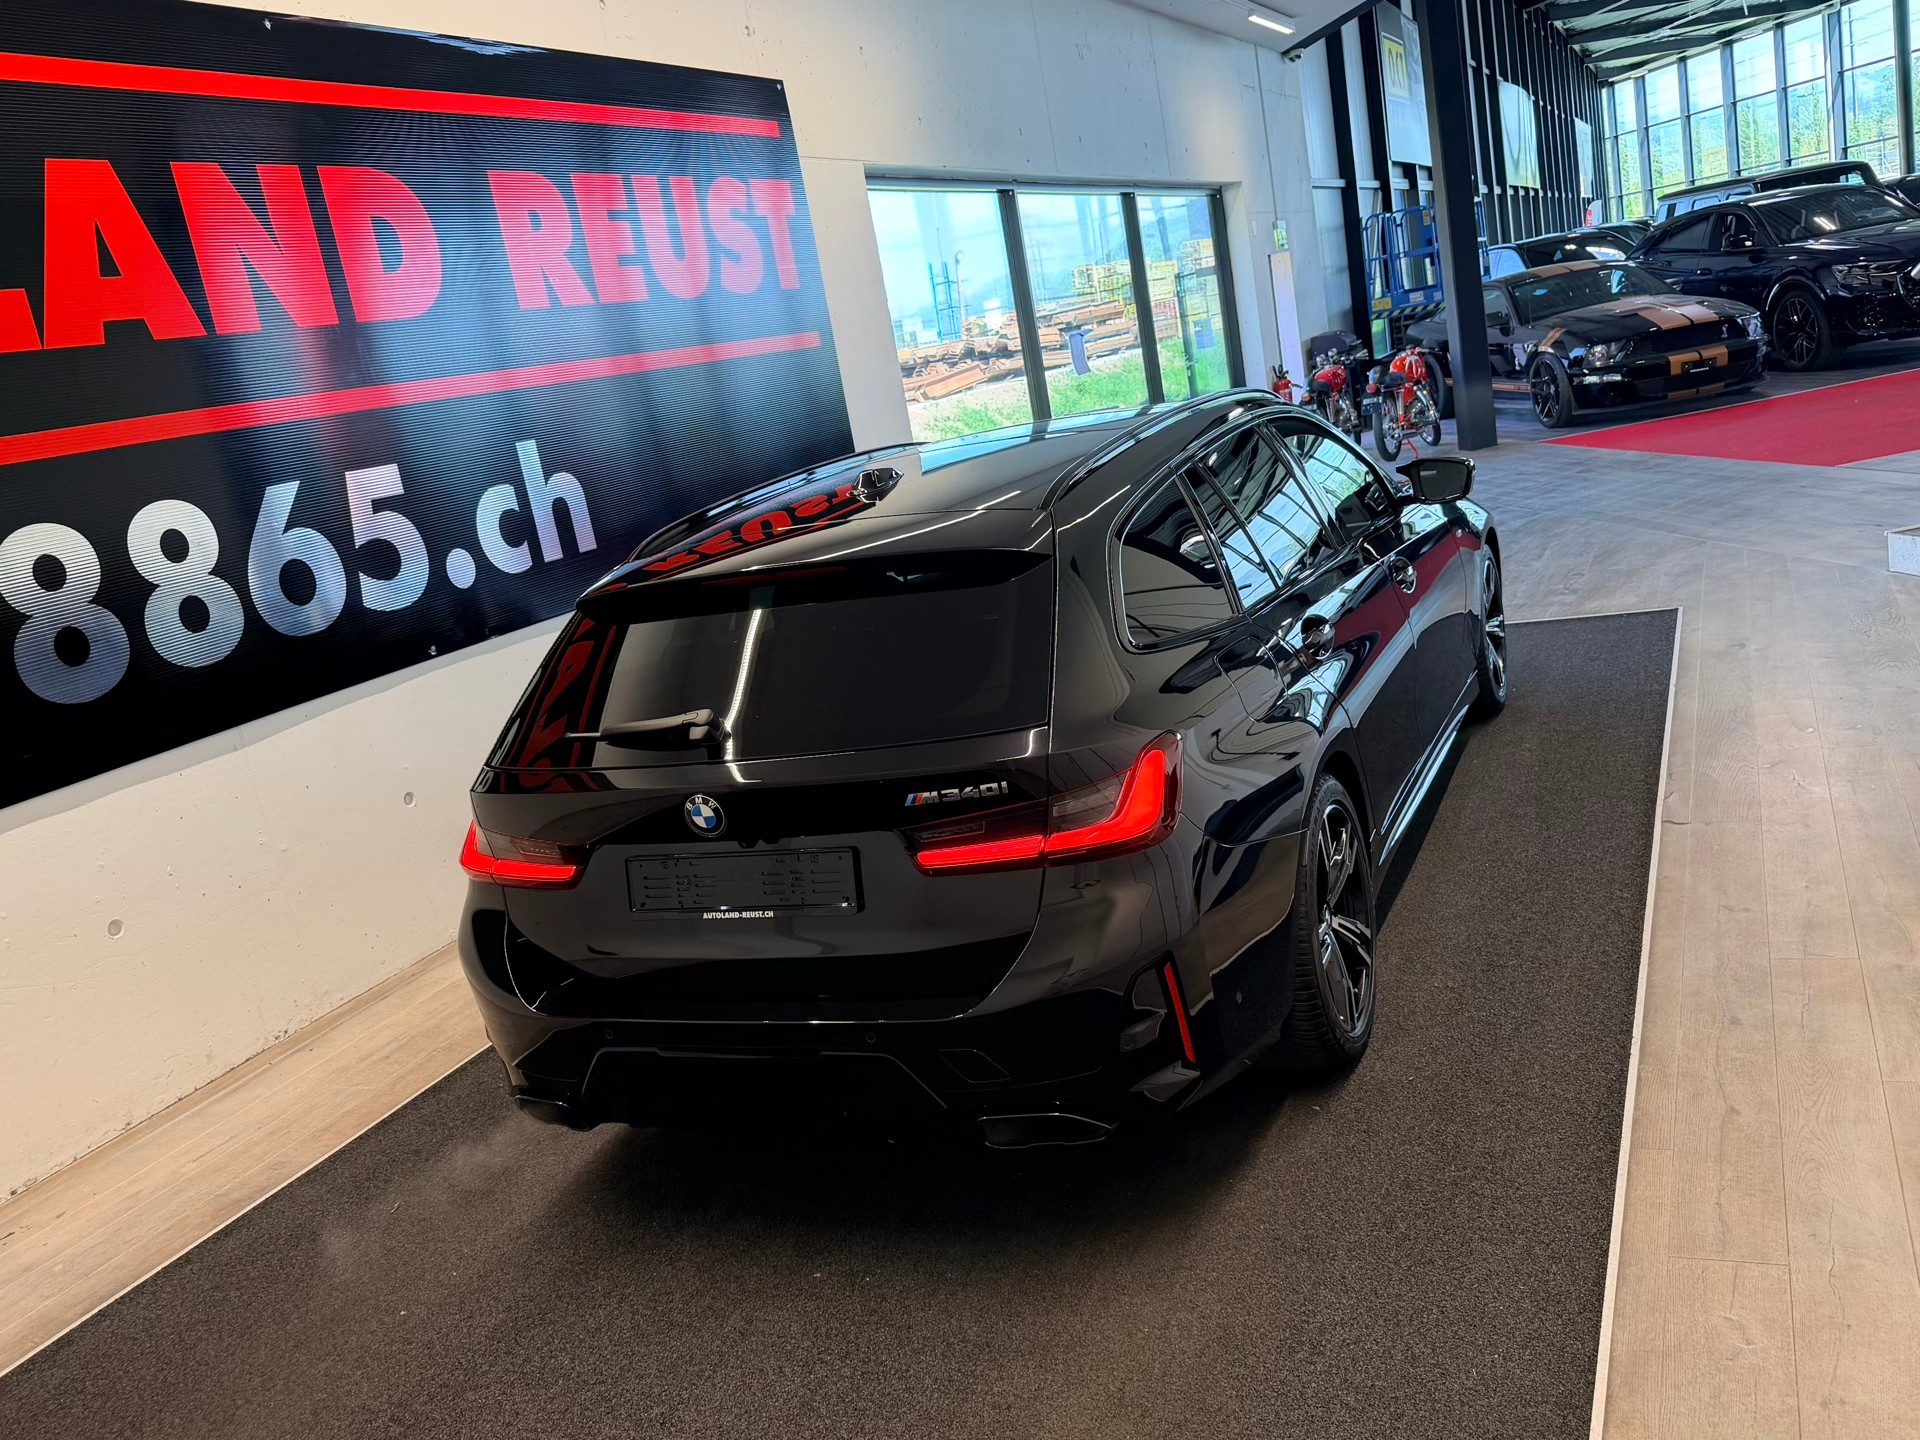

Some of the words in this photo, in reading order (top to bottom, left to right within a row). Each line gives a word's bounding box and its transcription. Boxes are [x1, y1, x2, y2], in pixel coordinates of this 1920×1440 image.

[487, 170, 800, 309] REUST
[0, 440, 597, 704] 8865.ch
[686, 797, 717, 810] BMW
[703, 910, 774, 919] AUTOLAND-REUST.CH
